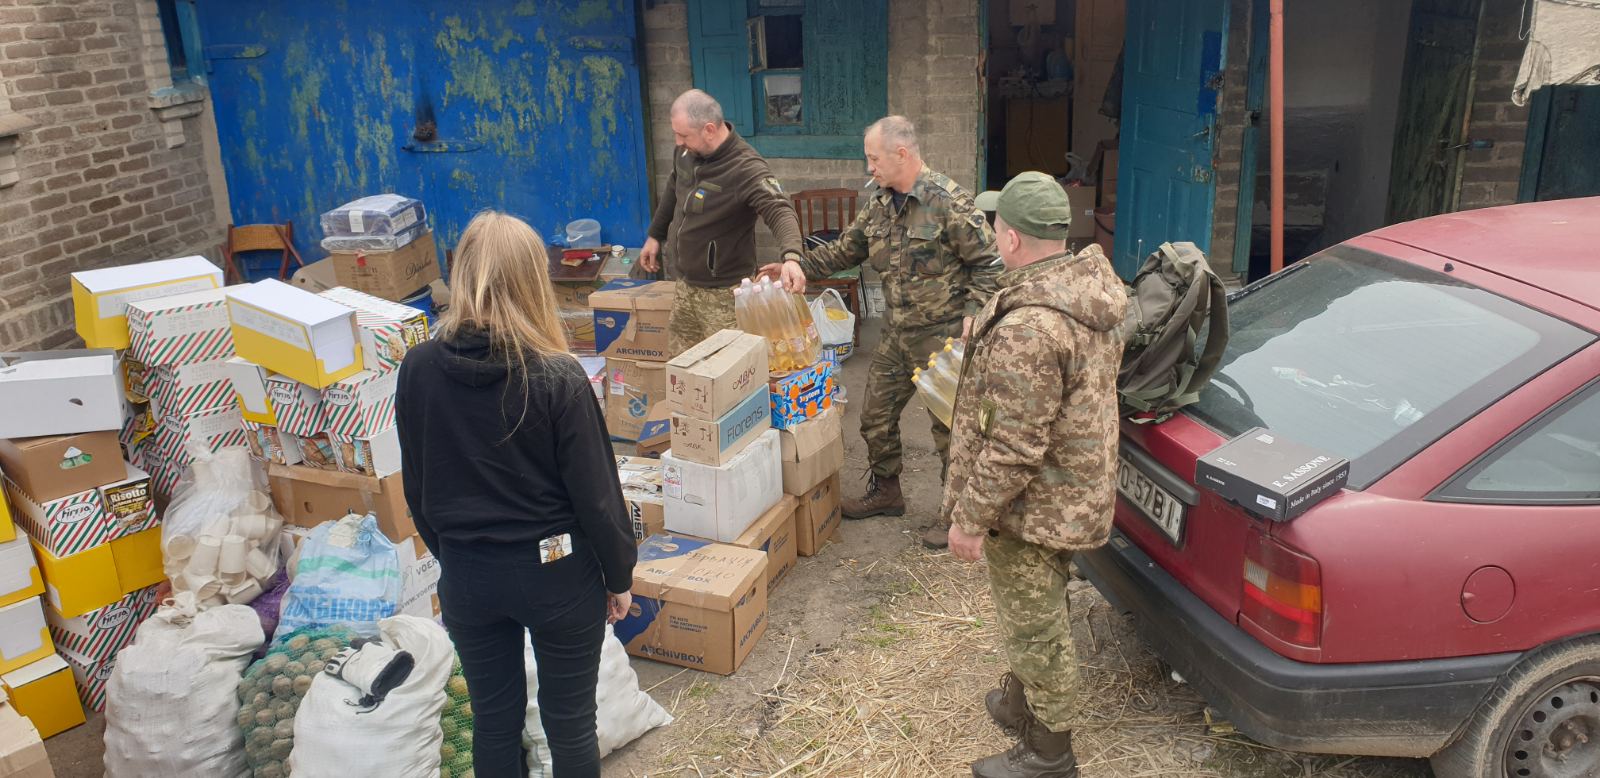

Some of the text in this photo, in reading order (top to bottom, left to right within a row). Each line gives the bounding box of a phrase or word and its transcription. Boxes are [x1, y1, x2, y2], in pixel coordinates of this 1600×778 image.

[616, 347, 664, 357] ARCHIVBOX
[727, 405, 763, 443] Florens
[1283, 455, 1331, 481] SASSONE
[110, 488, 147, 503] Risotto
[640, 644, 704, 664] ARCHIVBOX
